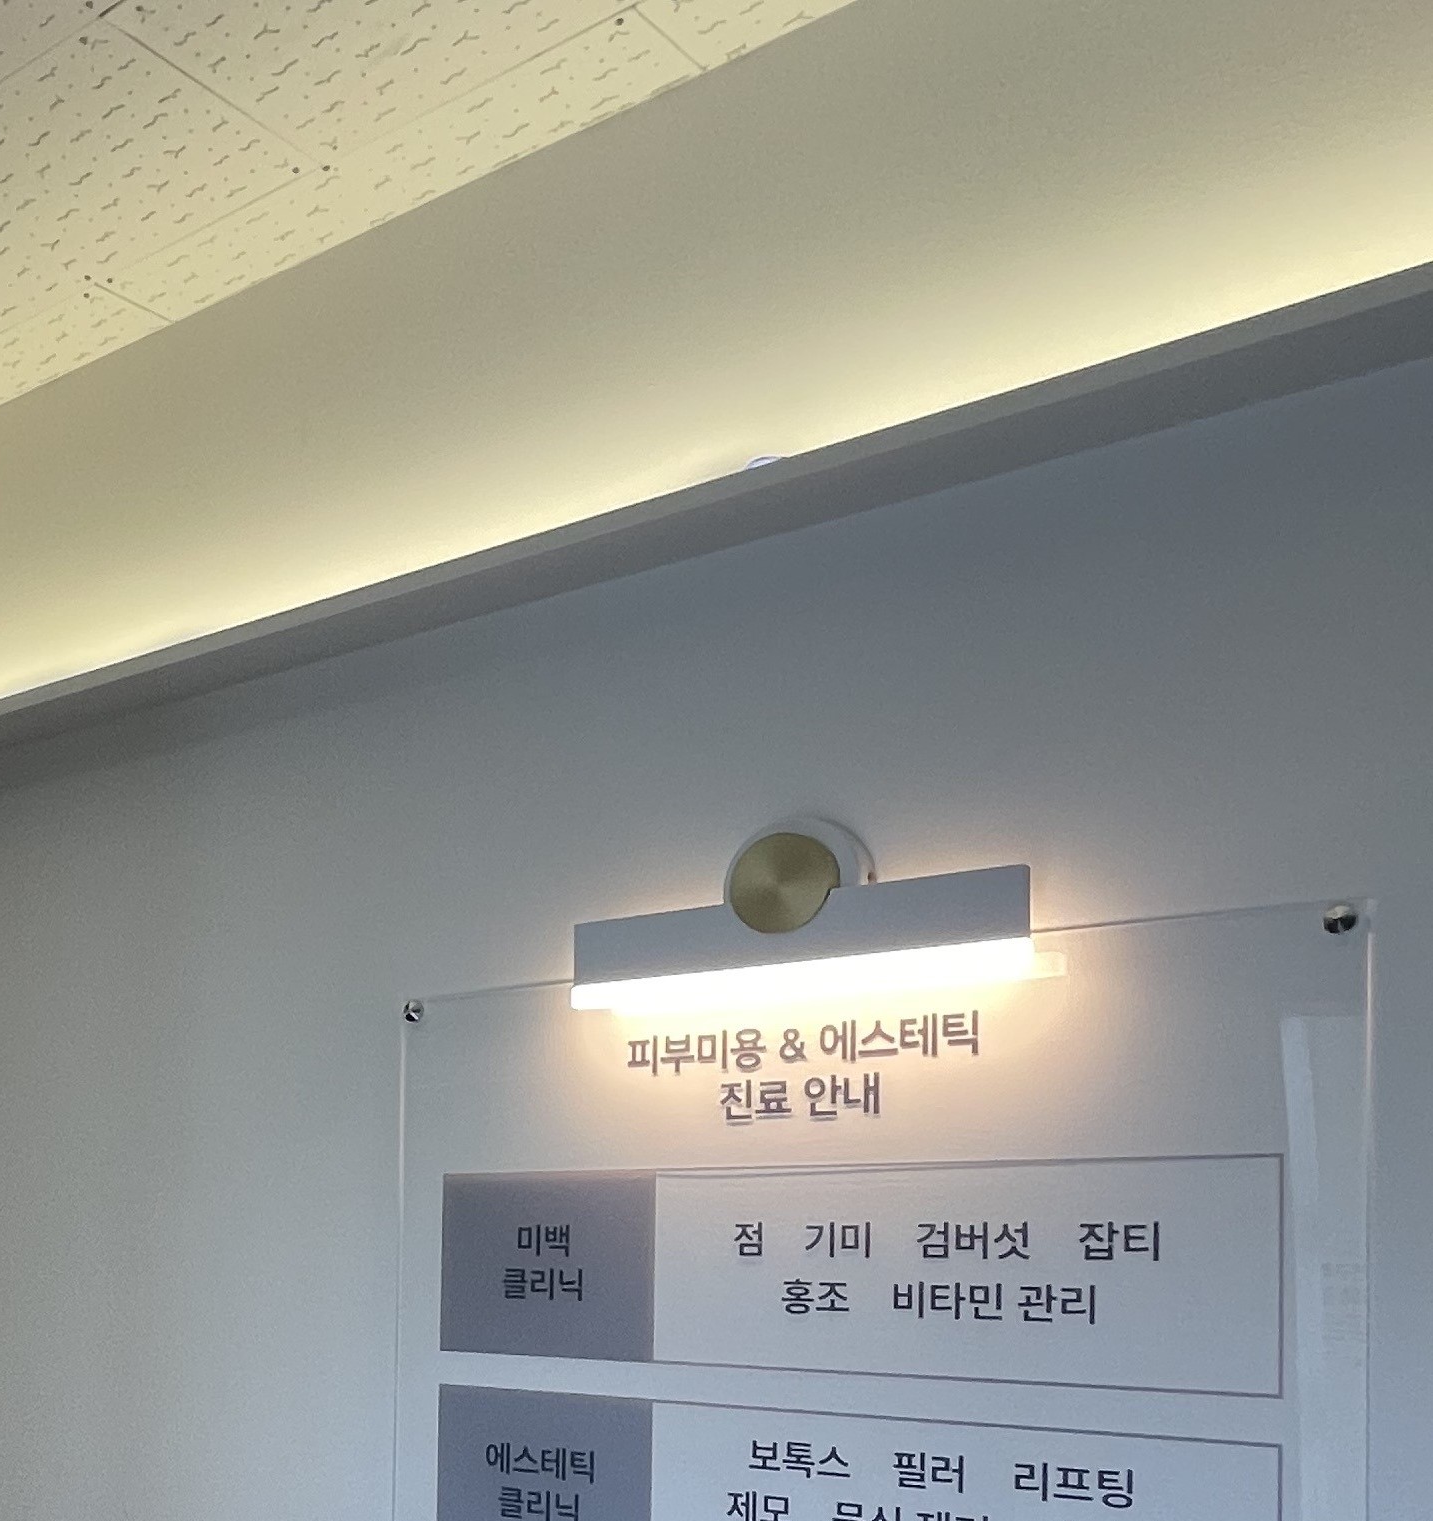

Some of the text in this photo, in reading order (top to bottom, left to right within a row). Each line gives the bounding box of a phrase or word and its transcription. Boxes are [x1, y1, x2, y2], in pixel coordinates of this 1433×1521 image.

[628, 1010, 979, 1075] 피부미용 & 에스테틱
[720, 1072, 879, 1122] 진료 안내
[518, 1225, 570, 1257] 미백
[734, 1221, 1159, 1261] 점 기미 검버섯 잡티
[502, 1268, 583, 1301] 클리닉
[782, 1279, 1095, 1325] 홍조 비타민 관리
[486, 1443, 594, 1484] 에스테틱
[749, 1440, 1133, 1509] 보톡스 필러 리프팅
